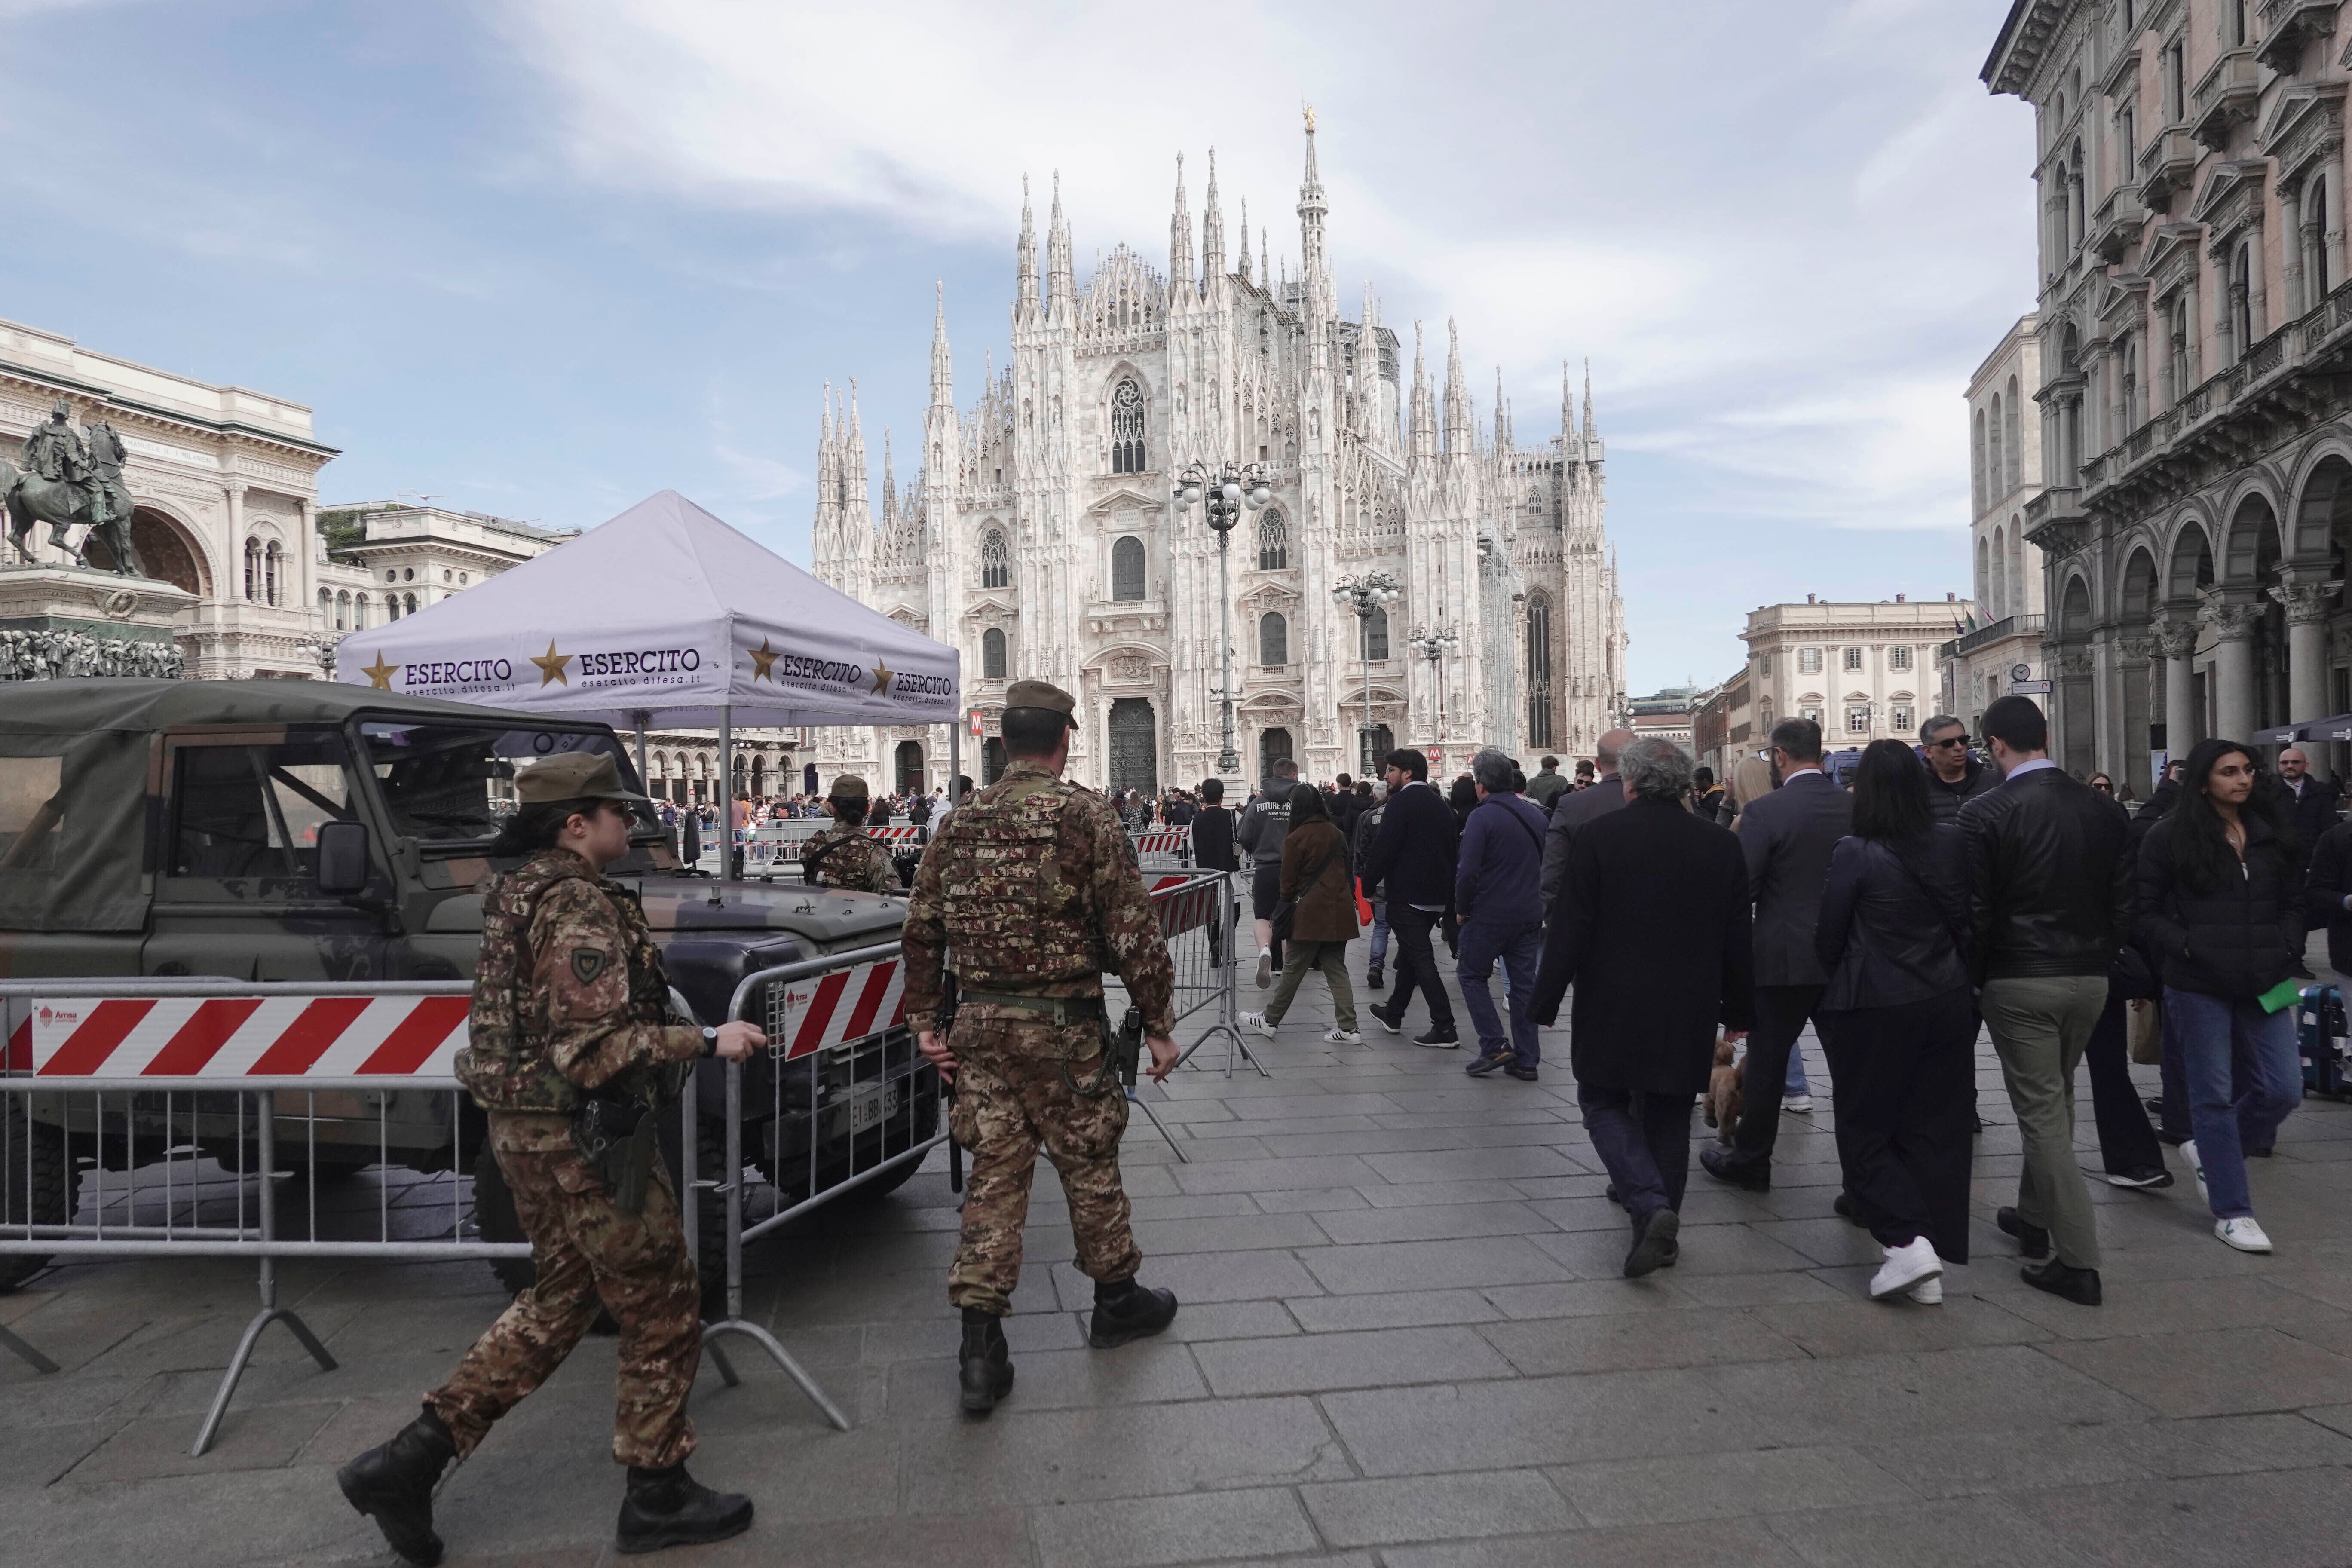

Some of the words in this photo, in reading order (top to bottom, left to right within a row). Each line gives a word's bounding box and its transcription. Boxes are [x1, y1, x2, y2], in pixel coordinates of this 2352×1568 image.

[123, 439, 160, 452] EMANUELE
[182, 452, 211, 463] MILANESI
[580, 649, 700, 675] ESERCITO
[782, 655, 861, 683] ESERCITO
[405, 659, 511, 685] ESERCITO
[582, 675, 700, 687] esercito.difesa.it
[781, 680, 856, 694] esercito.difesa.it
[896, 672, 951, 696] ESERCITO
[406, 683, 515, 696] esercito.difesa.it
[893, 694, 950, 705] esercito.difesa.it
[972, 715, 982, 730] M
[1430, 749, 1440, 757] M
[1256, 802, 1280, 812] FUTURE
